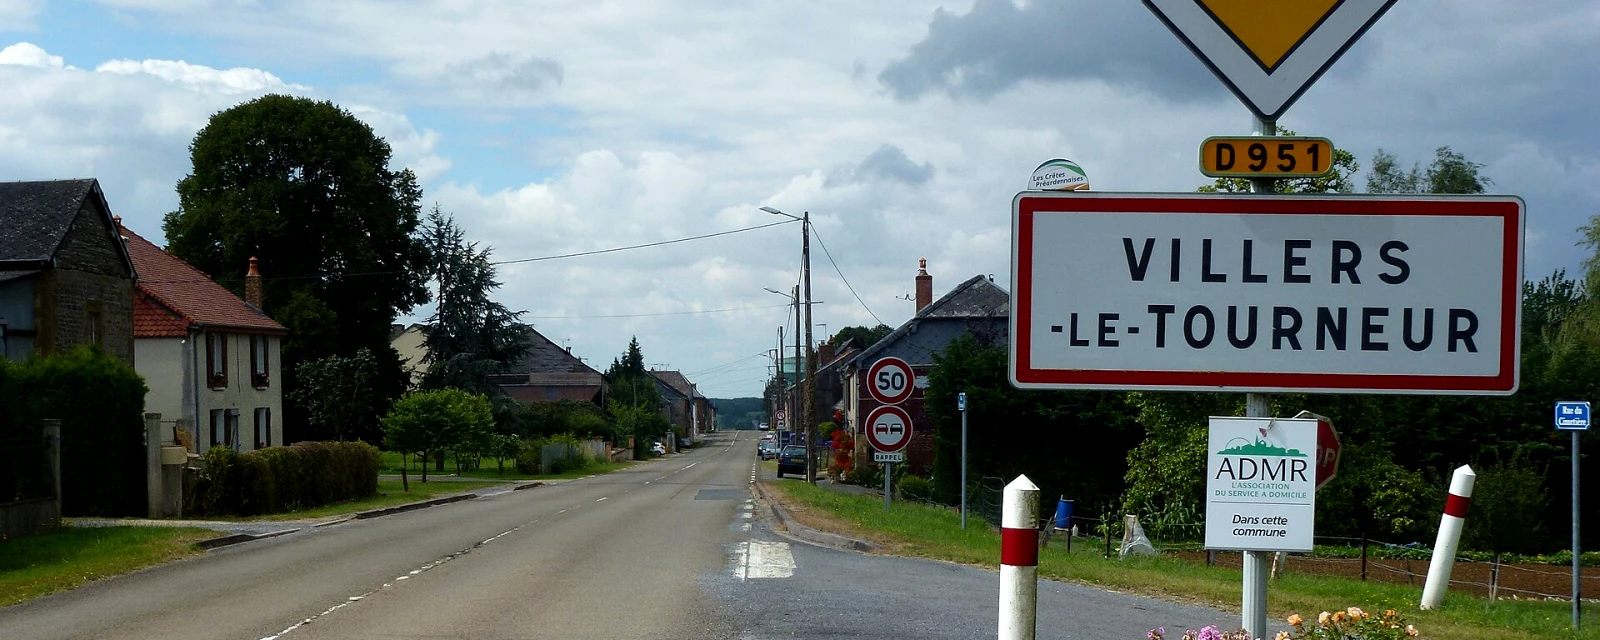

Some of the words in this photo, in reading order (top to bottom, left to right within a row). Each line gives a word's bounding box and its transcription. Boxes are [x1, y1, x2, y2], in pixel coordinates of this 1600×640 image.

[1122, 238, 1410, 284] VILLERS
[878, 372, 904, 390] 50
[1562, 406, 1574, 414] Rue
[1574, 406, 1582, 414] du
[1215, 457, 1308, 482] ADMR
[1231, 482, 1290, 490] L'ASSOCIATION
[1228, 490, 1259, 498] SERVICE
[1269, 491, 1307, 499] DOMICILE
[1232, 514, 1259, 525] Dans
[1261, 515, 1288, 526] cette
[1232, 527, 1287, 537] commune
